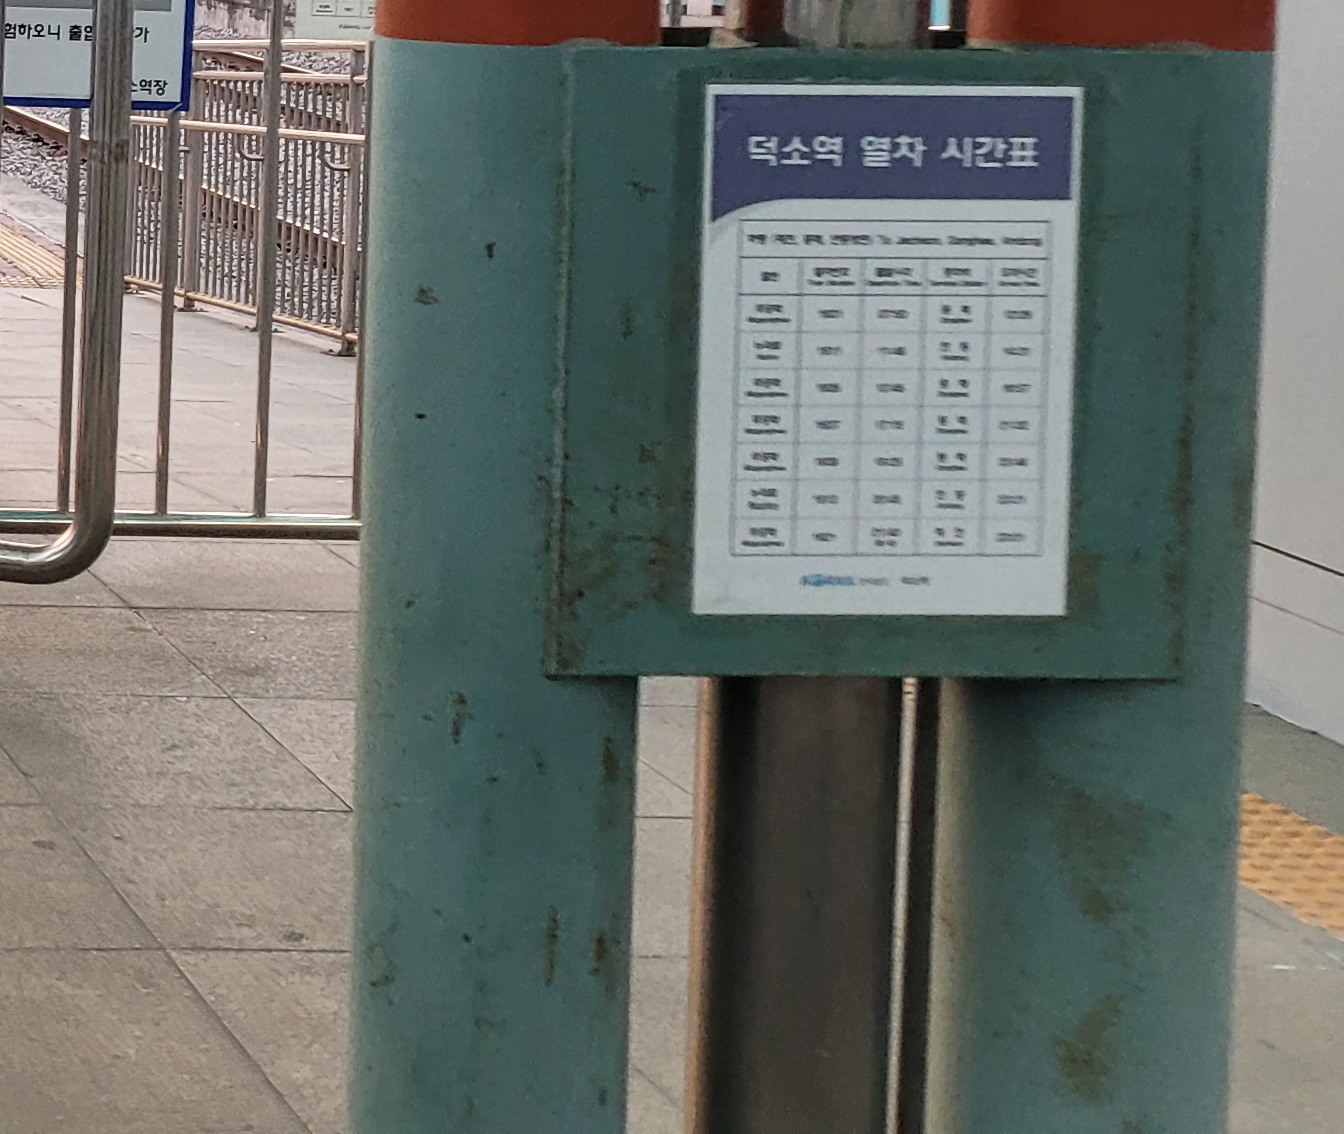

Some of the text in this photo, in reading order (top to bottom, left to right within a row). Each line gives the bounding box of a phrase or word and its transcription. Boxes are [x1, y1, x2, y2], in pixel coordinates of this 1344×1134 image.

[68, 24, 93, 42] 출입
[131, 78, 168, 97] 역장
[747, 134, 1040, 168] 덕소역 열차 시간표
